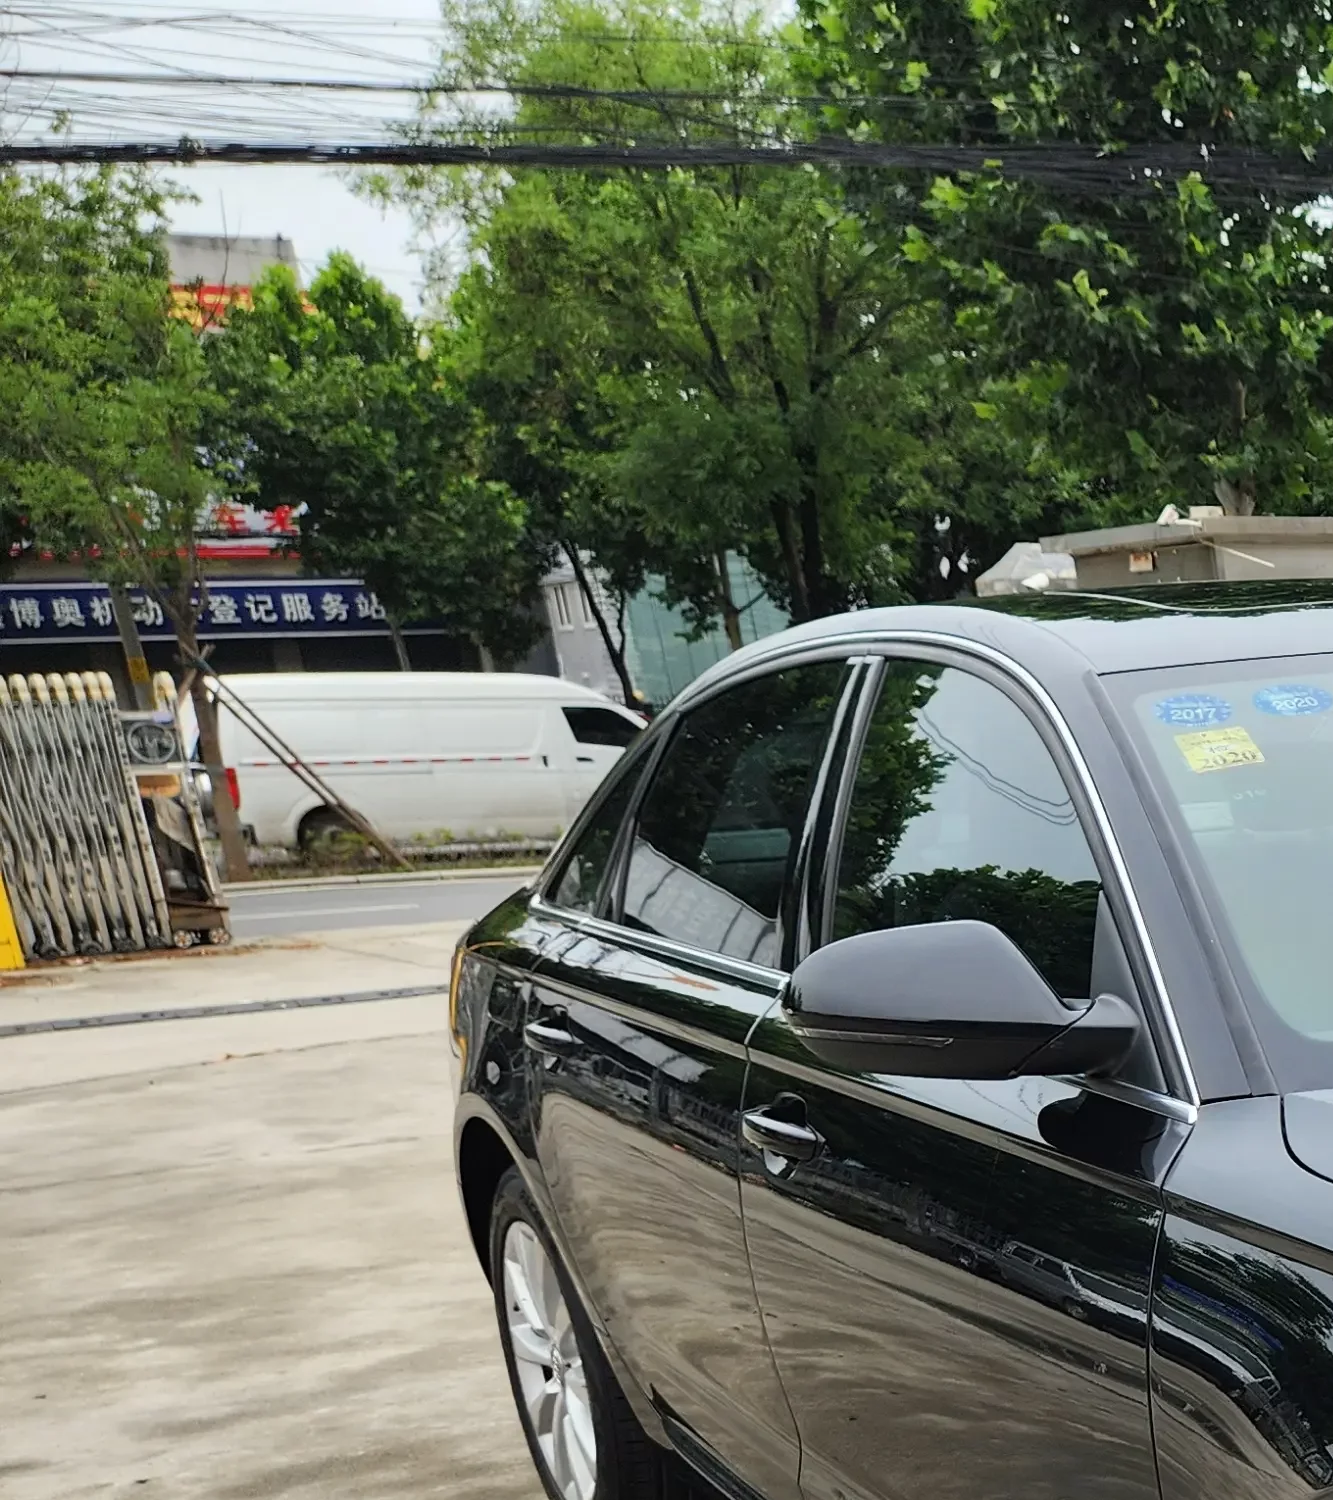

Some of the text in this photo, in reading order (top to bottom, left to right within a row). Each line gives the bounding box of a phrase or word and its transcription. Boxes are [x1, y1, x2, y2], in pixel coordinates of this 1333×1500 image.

[1272, 695, 1319, 711] 2020
[1169, 707, 1217, 721] 2017
[1198, 749, 1258, 770] 2020
